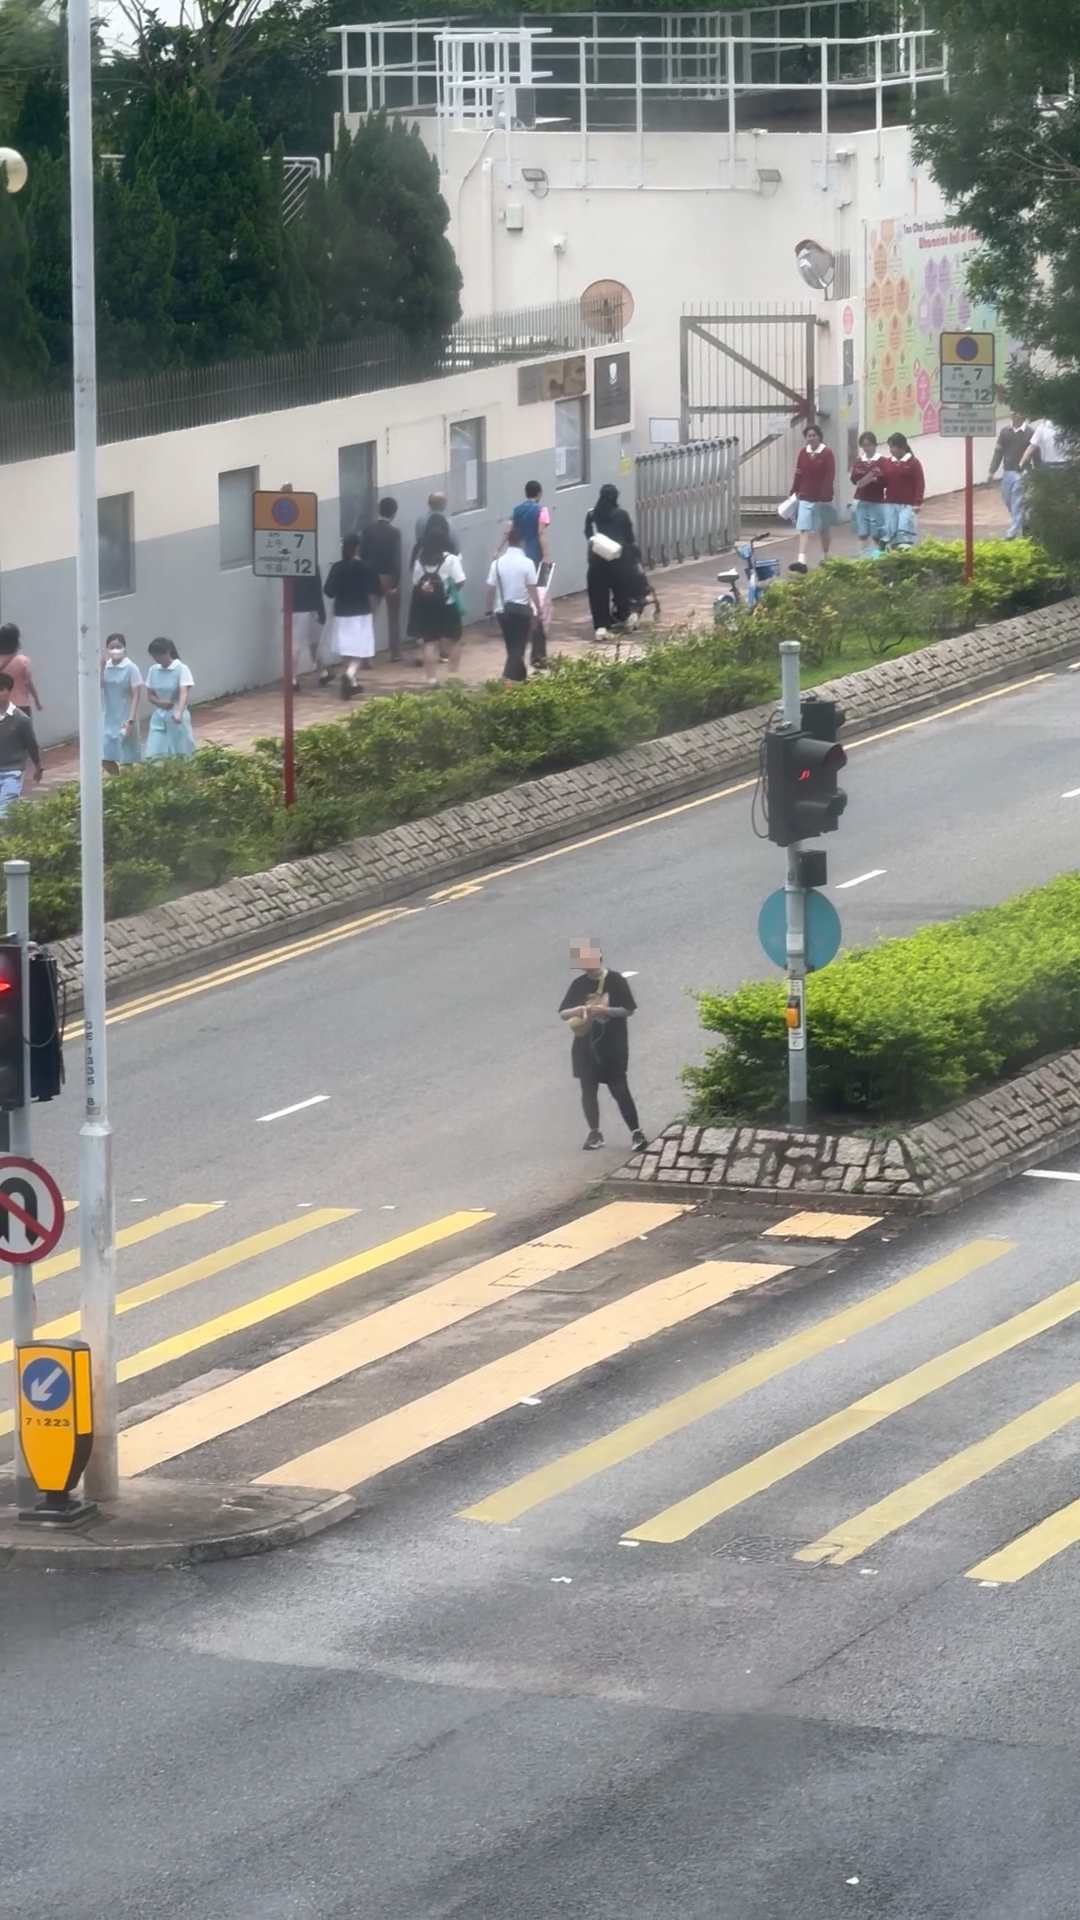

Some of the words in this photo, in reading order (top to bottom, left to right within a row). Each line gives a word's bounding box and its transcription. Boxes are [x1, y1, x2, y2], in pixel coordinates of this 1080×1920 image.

[974, 368, 983, 380] 7
[974, 388, 990, 401] 12
[294, 534, 304, 548] 7
[294, 559, 312, 574] 12
